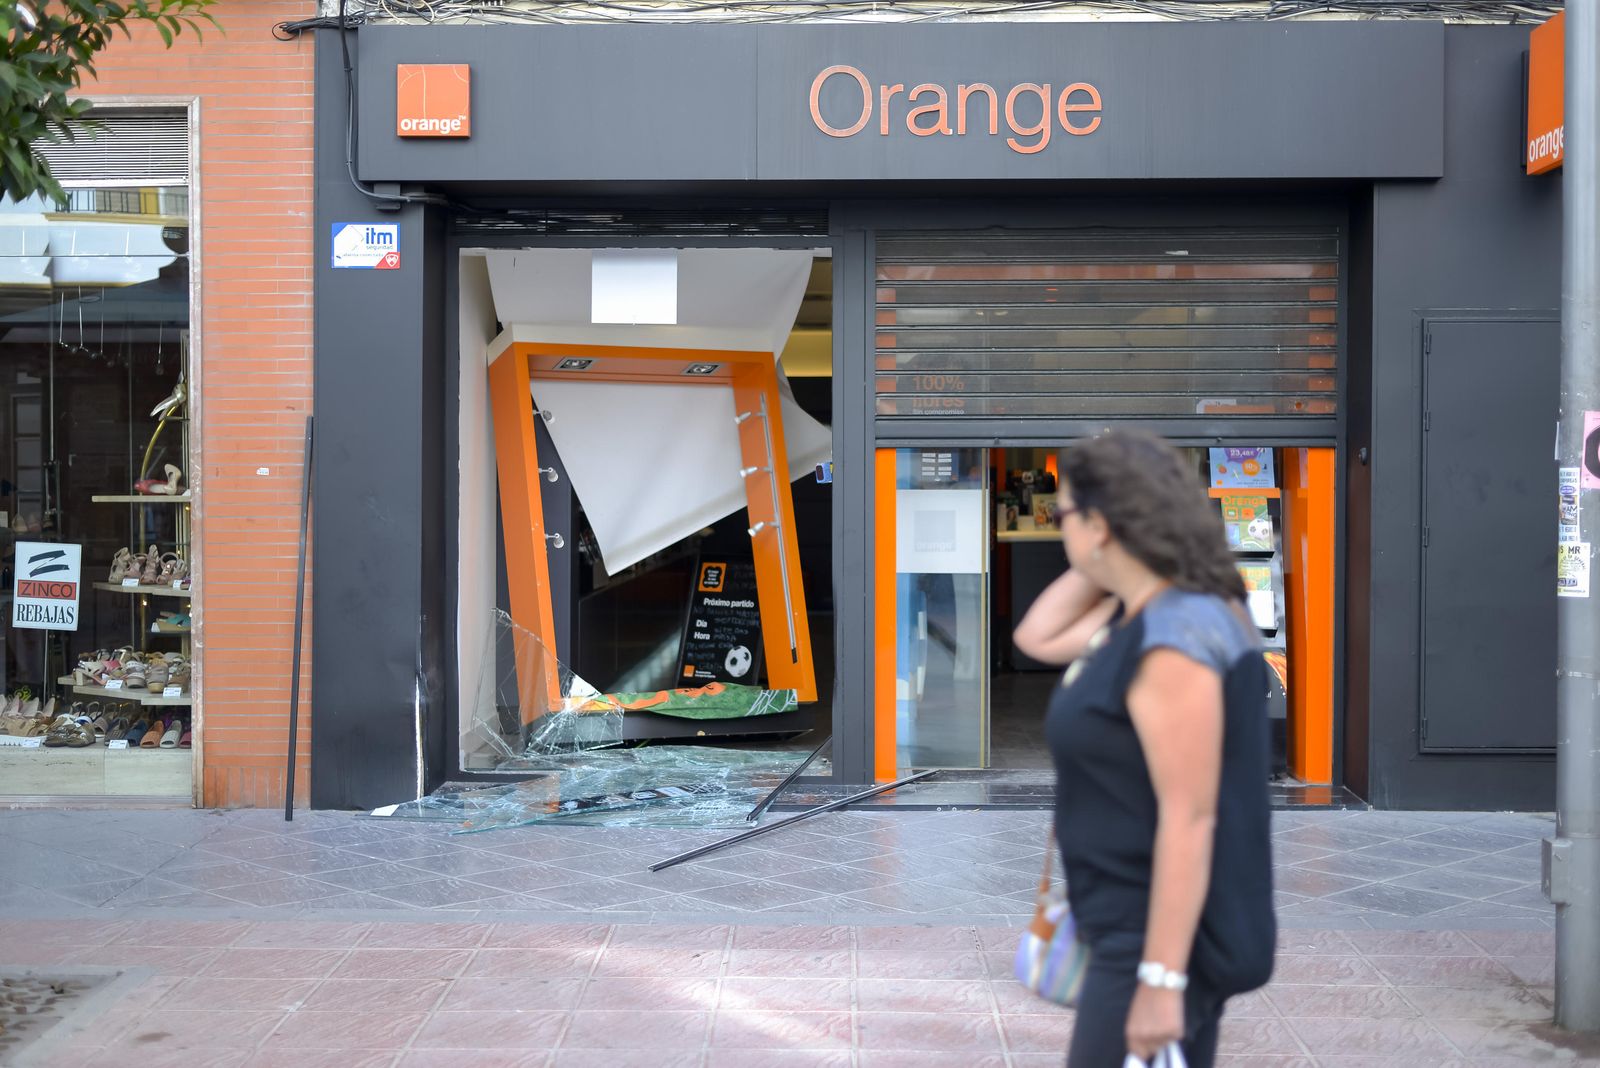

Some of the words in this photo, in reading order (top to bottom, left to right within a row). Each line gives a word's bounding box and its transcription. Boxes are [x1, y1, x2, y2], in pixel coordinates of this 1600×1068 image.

[809, 64, 1103, 154] Orange
[366, 227, 393, 245] itm
[911, 374, 965, 391] 100%
[20, 582, 73, 598] ZINCO
[703, 597, 731, 607] Próximo
[730, 599, 755, 609] partido
[16, 603, 75, 624] REBAJAS
[693, 631, 711, 640] Hora
